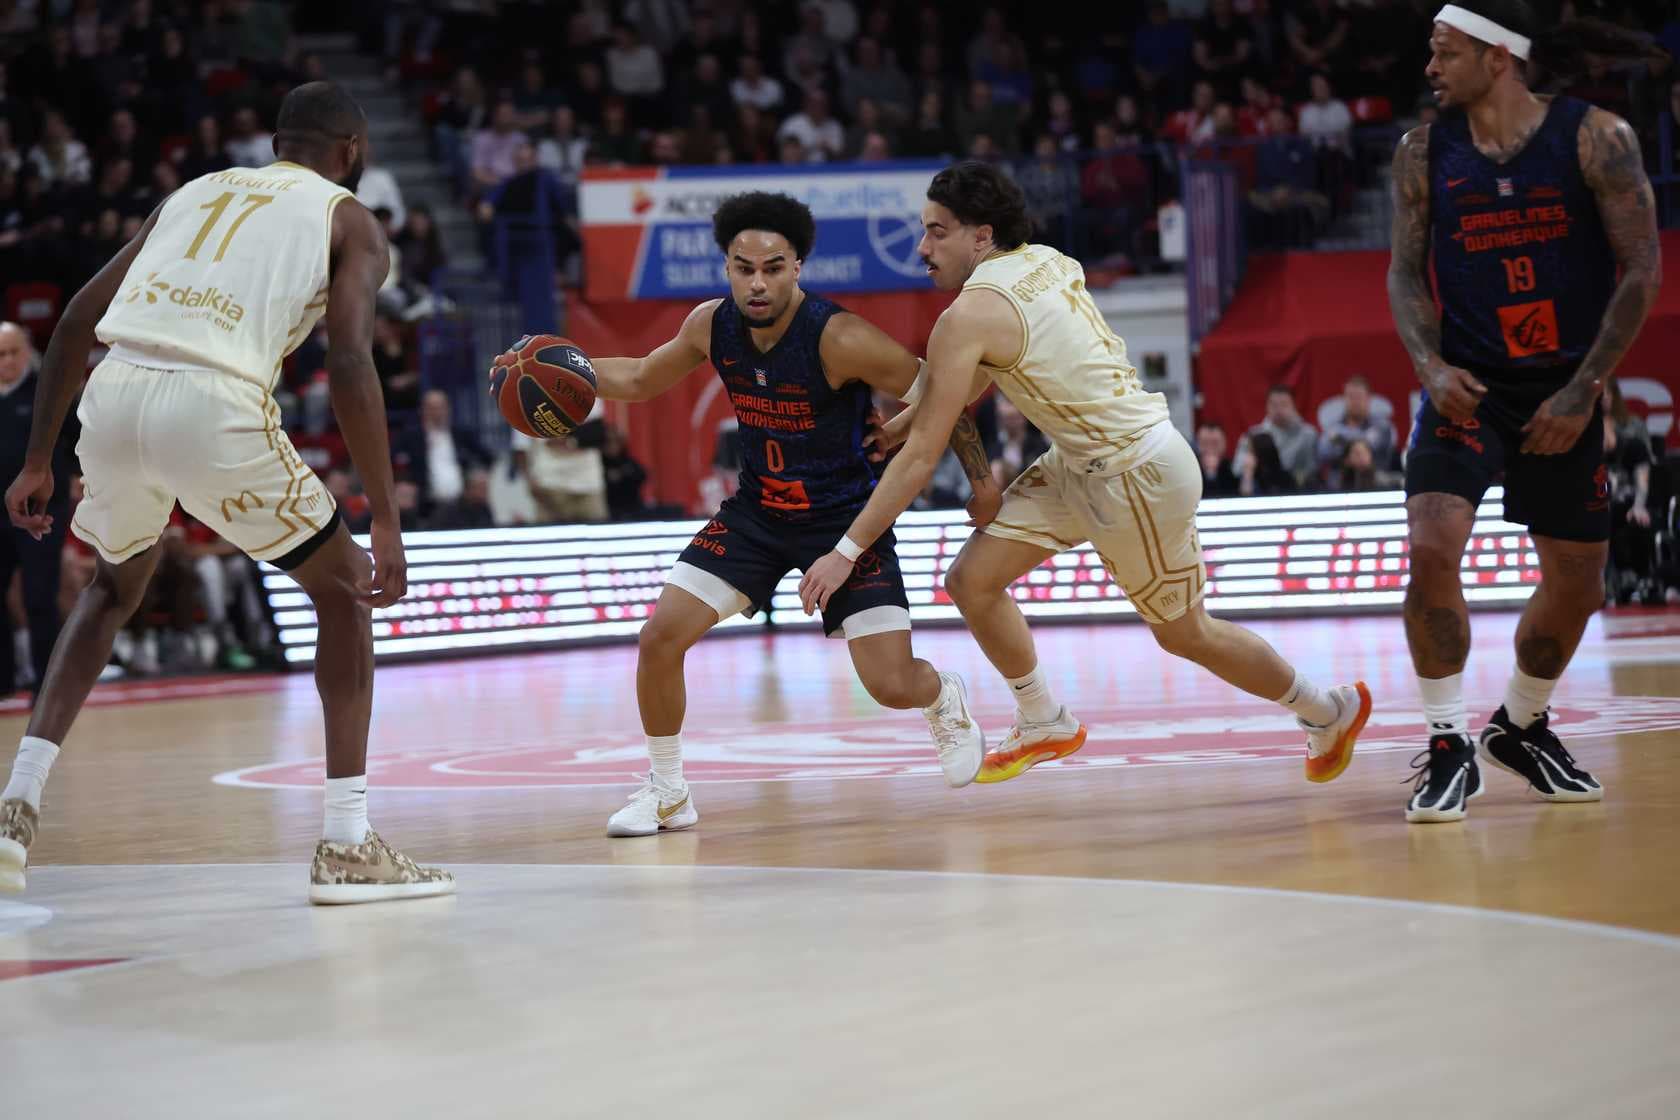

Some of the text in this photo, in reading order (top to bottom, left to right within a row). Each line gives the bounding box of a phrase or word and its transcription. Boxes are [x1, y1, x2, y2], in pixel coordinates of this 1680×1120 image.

[183, 191, 275, 263] 17
[1502, 255, 1536, 294] 19
[168, 286, 245, 321] dalkia
[766, 439, 784, 473] 0
